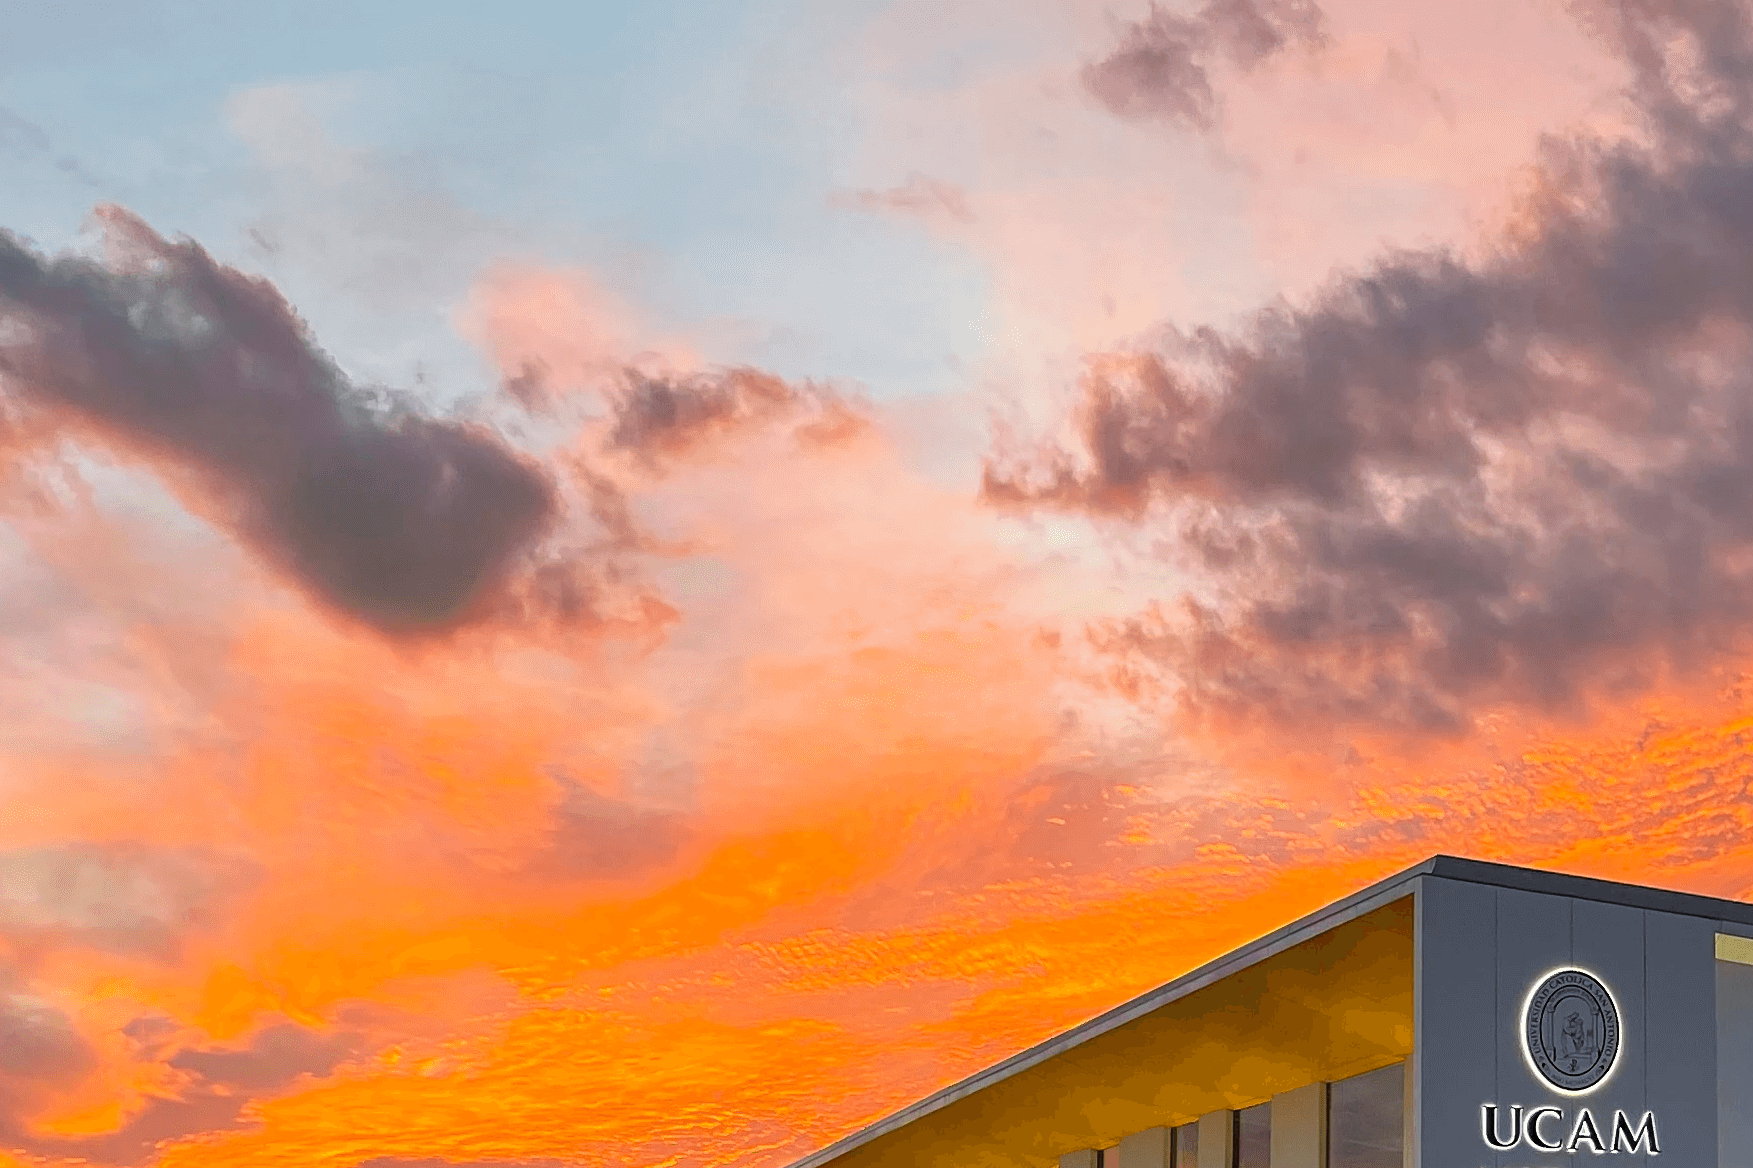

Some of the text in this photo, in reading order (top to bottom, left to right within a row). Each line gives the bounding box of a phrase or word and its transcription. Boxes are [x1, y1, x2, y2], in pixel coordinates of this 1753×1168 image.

[1530, 988, 1550, 1055] UNIVERSIDAD
[1595, 989, 1608, 1007] SAN
[1604, 1009, 1615, 1057] ANTONIO
[1482, 1104, 1662, 1154] UCAM
